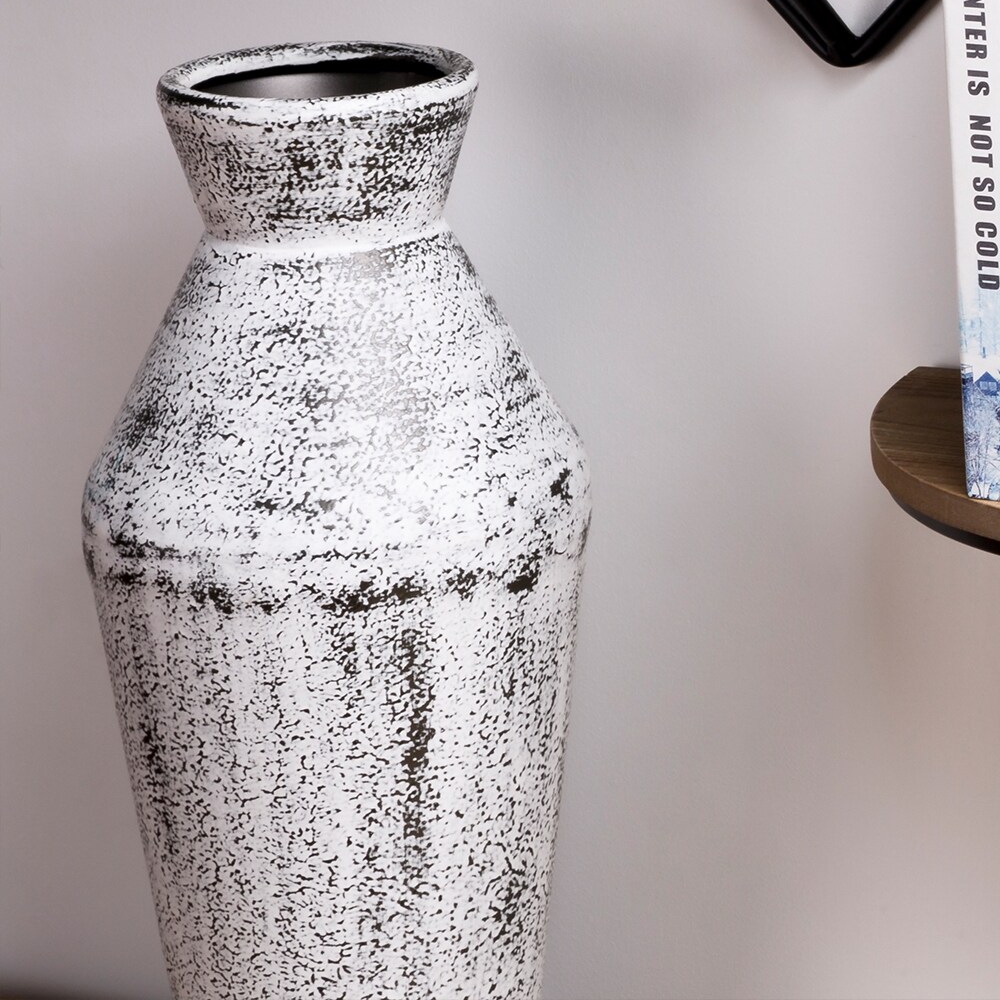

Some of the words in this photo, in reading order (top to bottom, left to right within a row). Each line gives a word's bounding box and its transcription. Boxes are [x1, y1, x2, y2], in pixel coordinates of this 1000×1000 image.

[967, 69, 990, 96] IS
[969, 114, 994, 168] NOT
[972, 176, 996, 212] SO
[975, 221, 1000, 291] COLD
